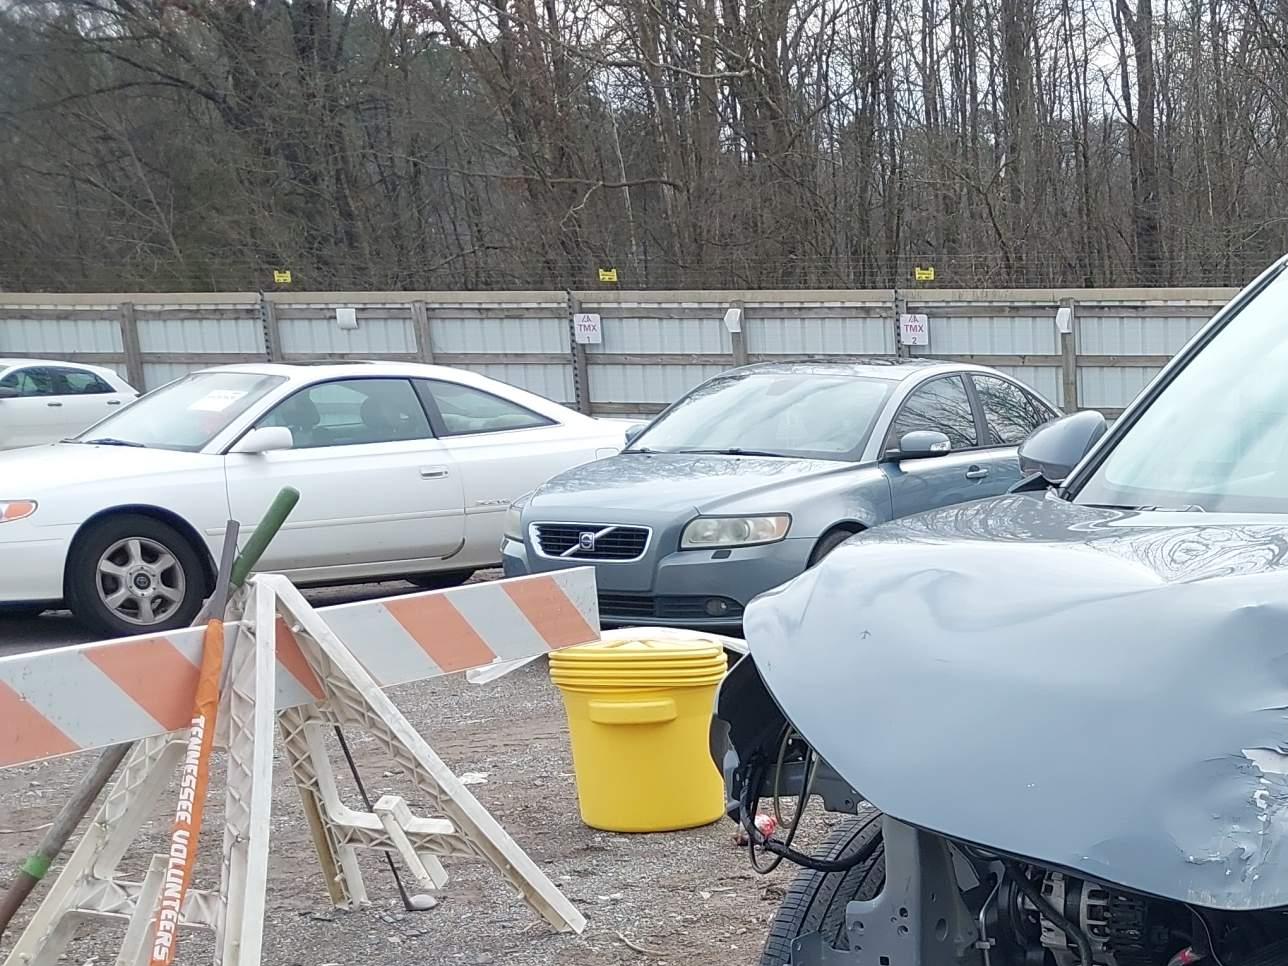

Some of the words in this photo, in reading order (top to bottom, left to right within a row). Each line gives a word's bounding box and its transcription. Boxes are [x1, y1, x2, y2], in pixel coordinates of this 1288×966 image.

[577, 323, 598, 333] TMX
[903, 324, 924, 333] TMX
[911, 336, 918, 344] 2
[175, 714, 205, 825] TENNESSEE
[153, 829, 190, 961] VOLUNTEERS
